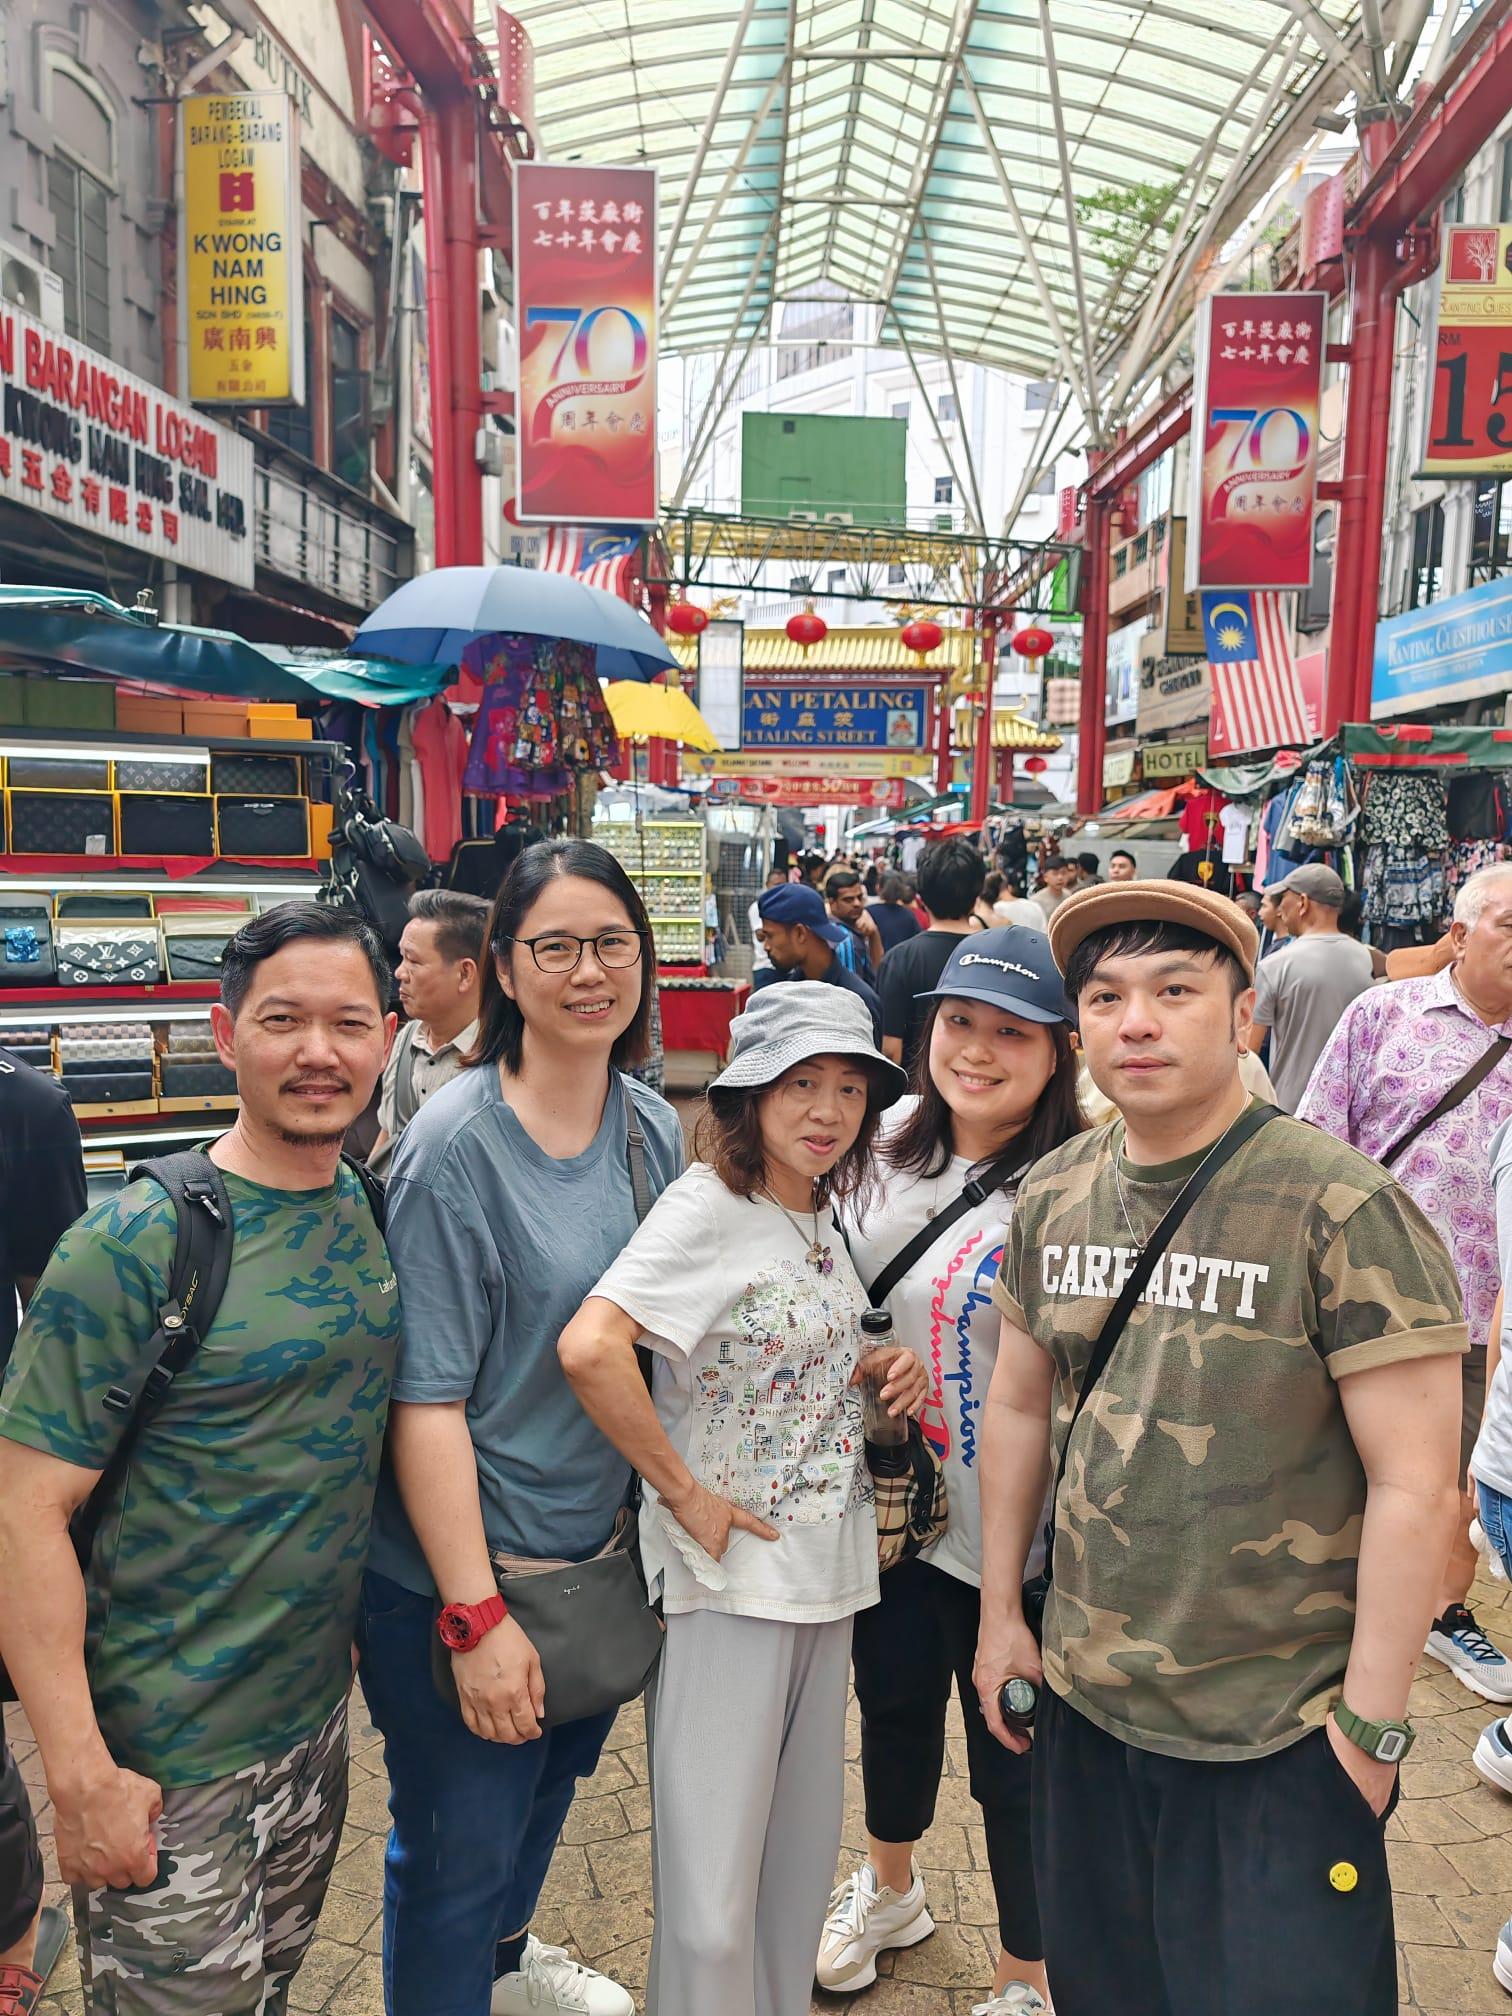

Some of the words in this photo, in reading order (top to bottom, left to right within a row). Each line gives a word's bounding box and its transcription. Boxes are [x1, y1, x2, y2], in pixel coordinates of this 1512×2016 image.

[191, 123, 281, 145] BARANG-BARANG
[194, 233, 282, 255] KWONG
[213, 260, 263, 279] NAM
[211, 286, 267, 305] HING
[202, 327, 278, 352] 廣南興
[527, 306, 647, 383] 70
[1438, 332, 1462, 347] RM
[26, 328, 148, 446] BARANGAN
[156, 403, 217, 480] LOGAM
[545, 381, 627, 409] ANNIVERSARY
[4, 383, 82, 465] KWONG
[88, 424, 130, 486] NAM
[135, 448, 174, 505] HING
[1210, 408, 1310, 472] 70
[744, 692, 782, 709] AN
[790, 692, 914, 709] PETALING
[816, 729, 878, 743] STREET
[1145, 751, 1204, 771] HOTEL
[958, 953, 1040, 981] Champion
[919, 1229, 983, 1463] Champion
